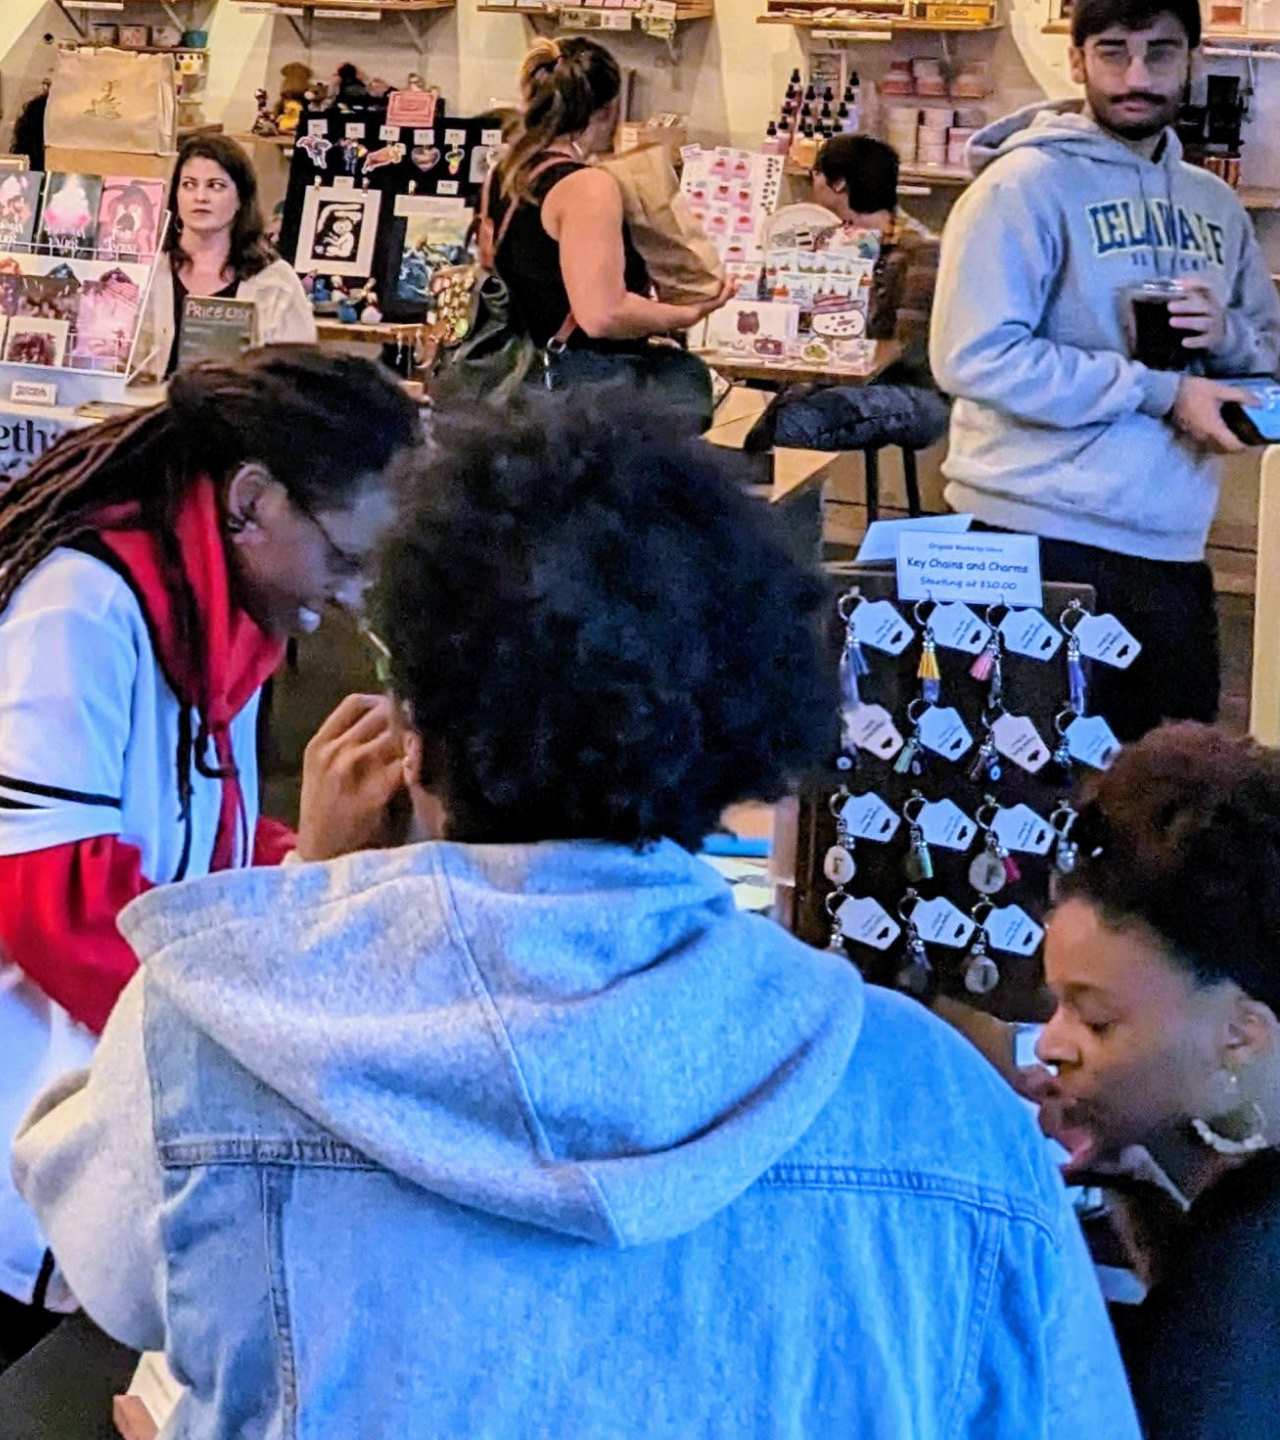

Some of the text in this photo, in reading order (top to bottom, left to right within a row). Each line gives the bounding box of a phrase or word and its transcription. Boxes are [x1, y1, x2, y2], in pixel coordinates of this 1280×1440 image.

[185, 300, 224, 318] PRICE
[907, 557, 1028, 573] Key Chains and Charms
[920, 576, 962, 589] Starting
